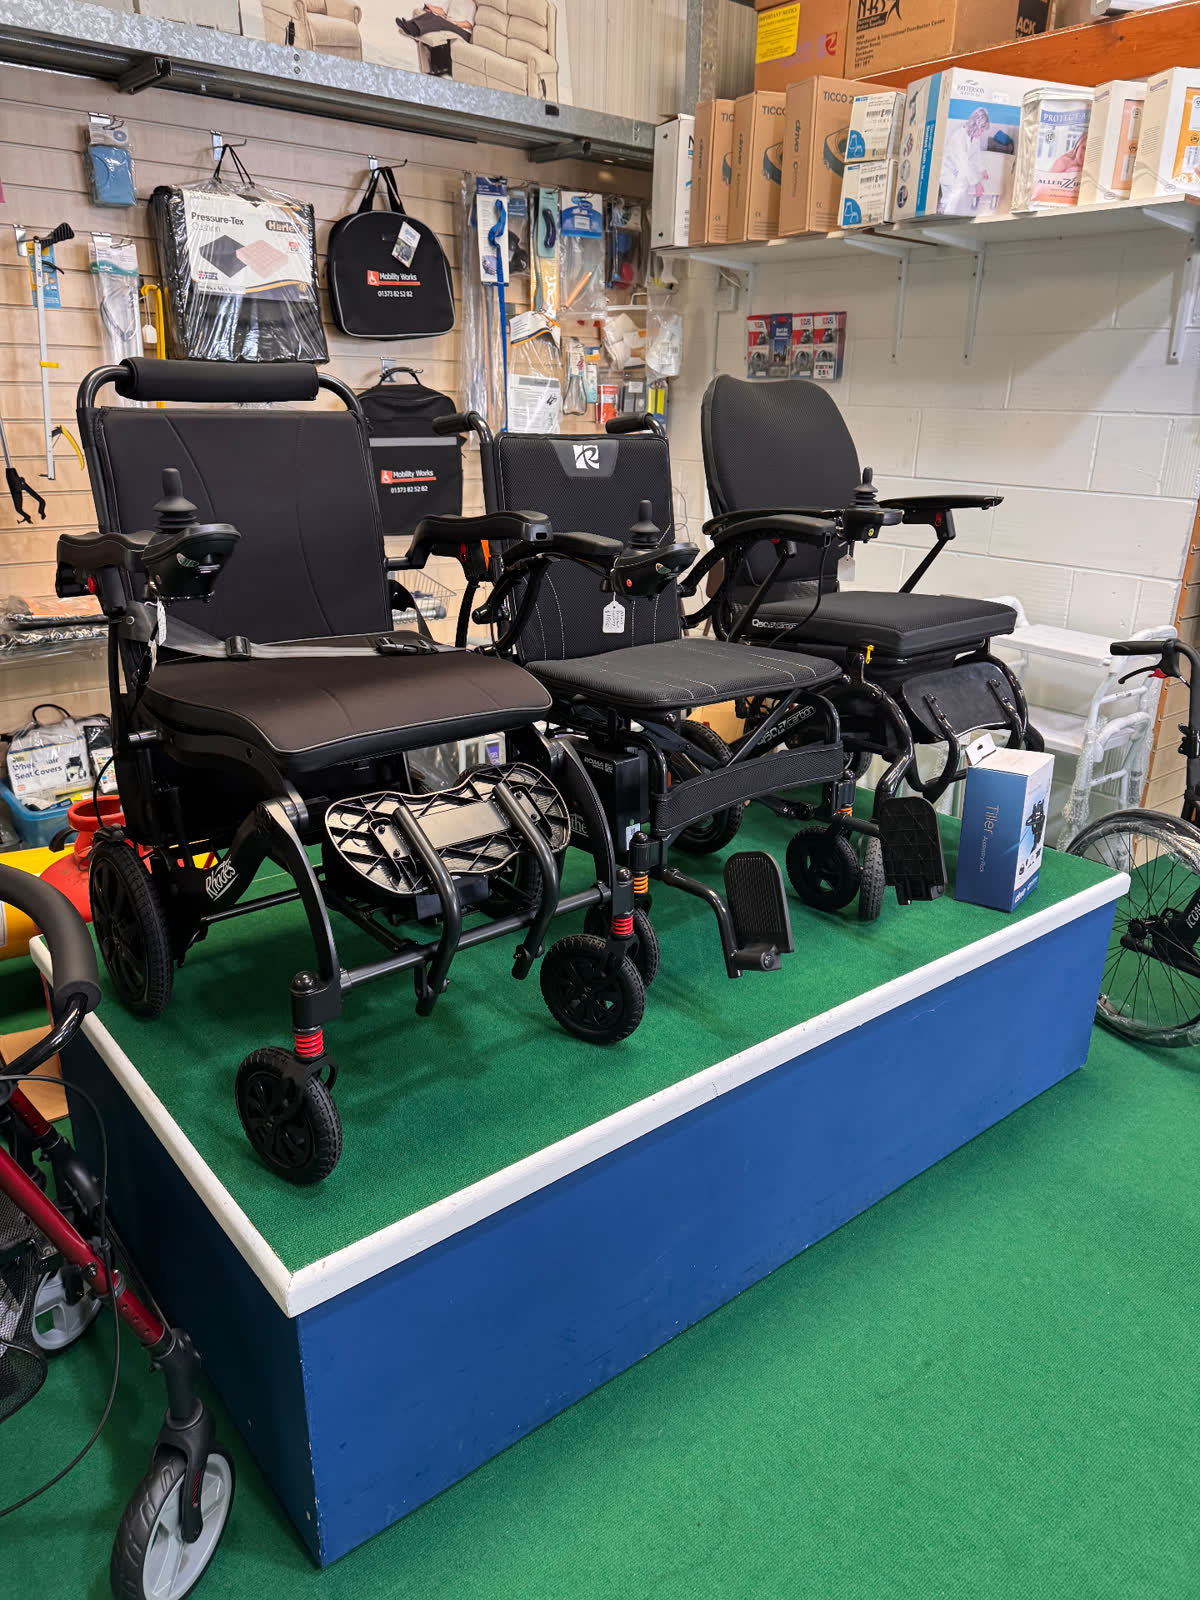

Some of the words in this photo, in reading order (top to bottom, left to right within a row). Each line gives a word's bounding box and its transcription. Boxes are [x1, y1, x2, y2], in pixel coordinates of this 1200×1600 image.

[823, 90, 848, 103] TICCO
[191, 211, 244, 226] Pressure-Tex
[268, 220, 302, 233] Harle
[380, 272, 400, 281] Mobility
[400, 273, 418, 281] Works
[377, 290, 393, 298] 01373
[393, 290, 400, 298] 82
[400, 290, 406, 298] 52
[406, 290, 413, 298] 82
[393, 470, 415, 479] Mobility
[415, 468, 434, 477] Works
[390, 486, 406, 494] 01373
[12, 757, 59, 771] Wheeair
[14, 771, 34, 781] Seat
[34, 766, 63, 777] Covers
[984, 804, 1000, 834] Tiller
[205, 854, 237, 900] Rhodes
